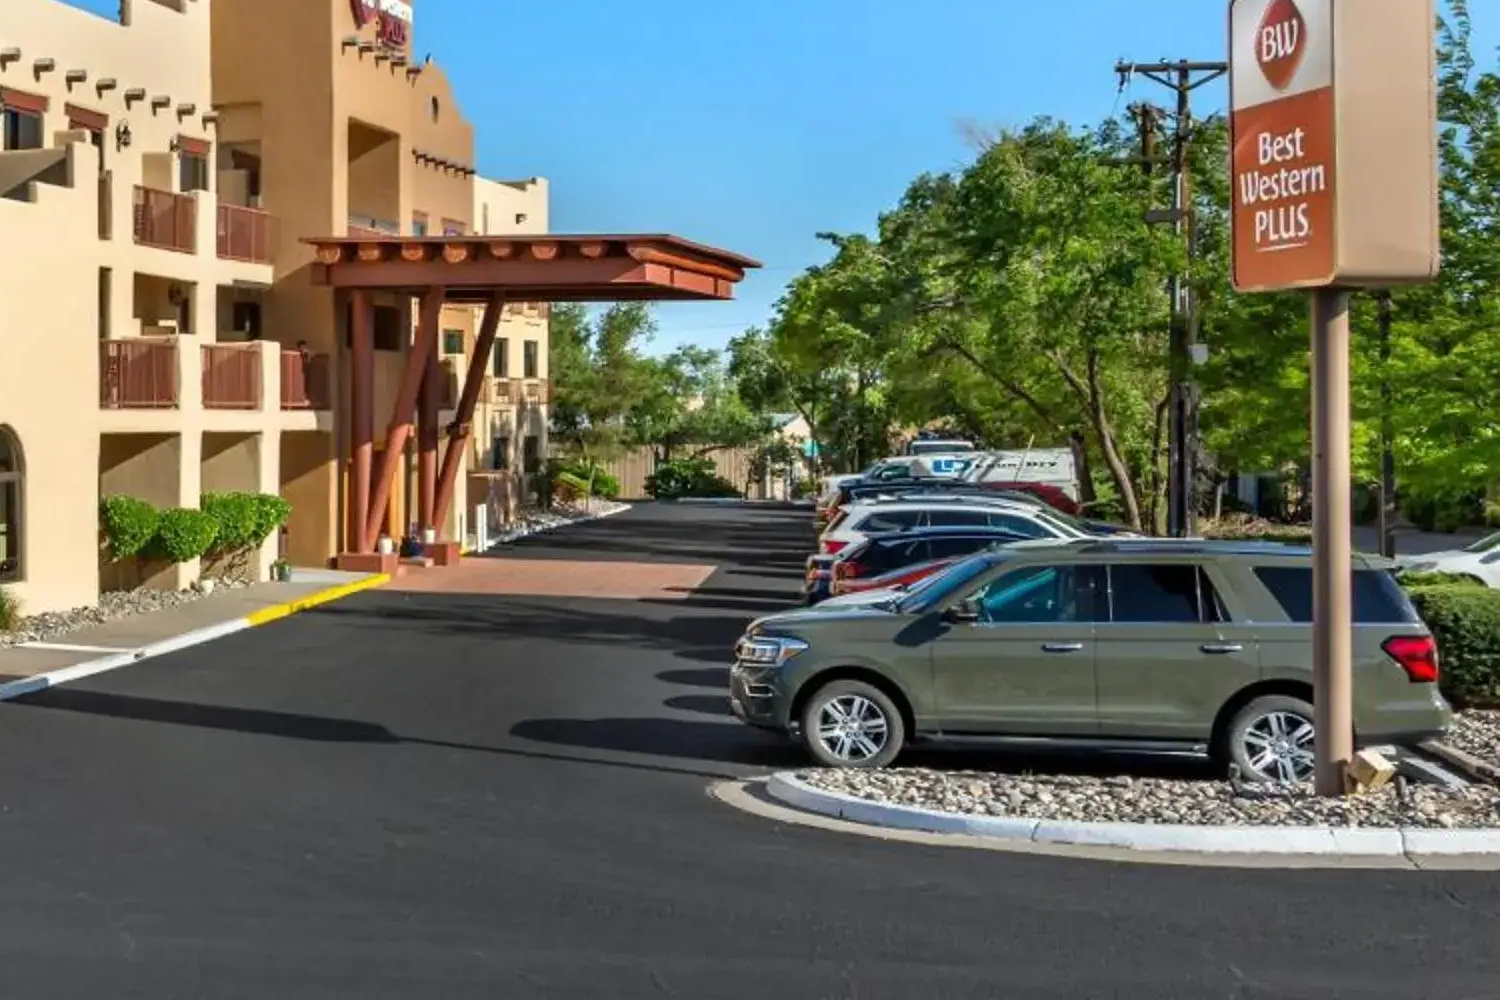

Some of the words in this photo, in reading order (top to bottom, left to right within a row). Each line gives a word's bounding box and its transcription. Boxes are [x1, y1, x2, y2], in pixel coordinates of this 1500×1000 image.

[1261, 17, 1299, 63] BW
[1258, 127, 1305, 166] Best
[1240, 164, 1325, 205] Western
